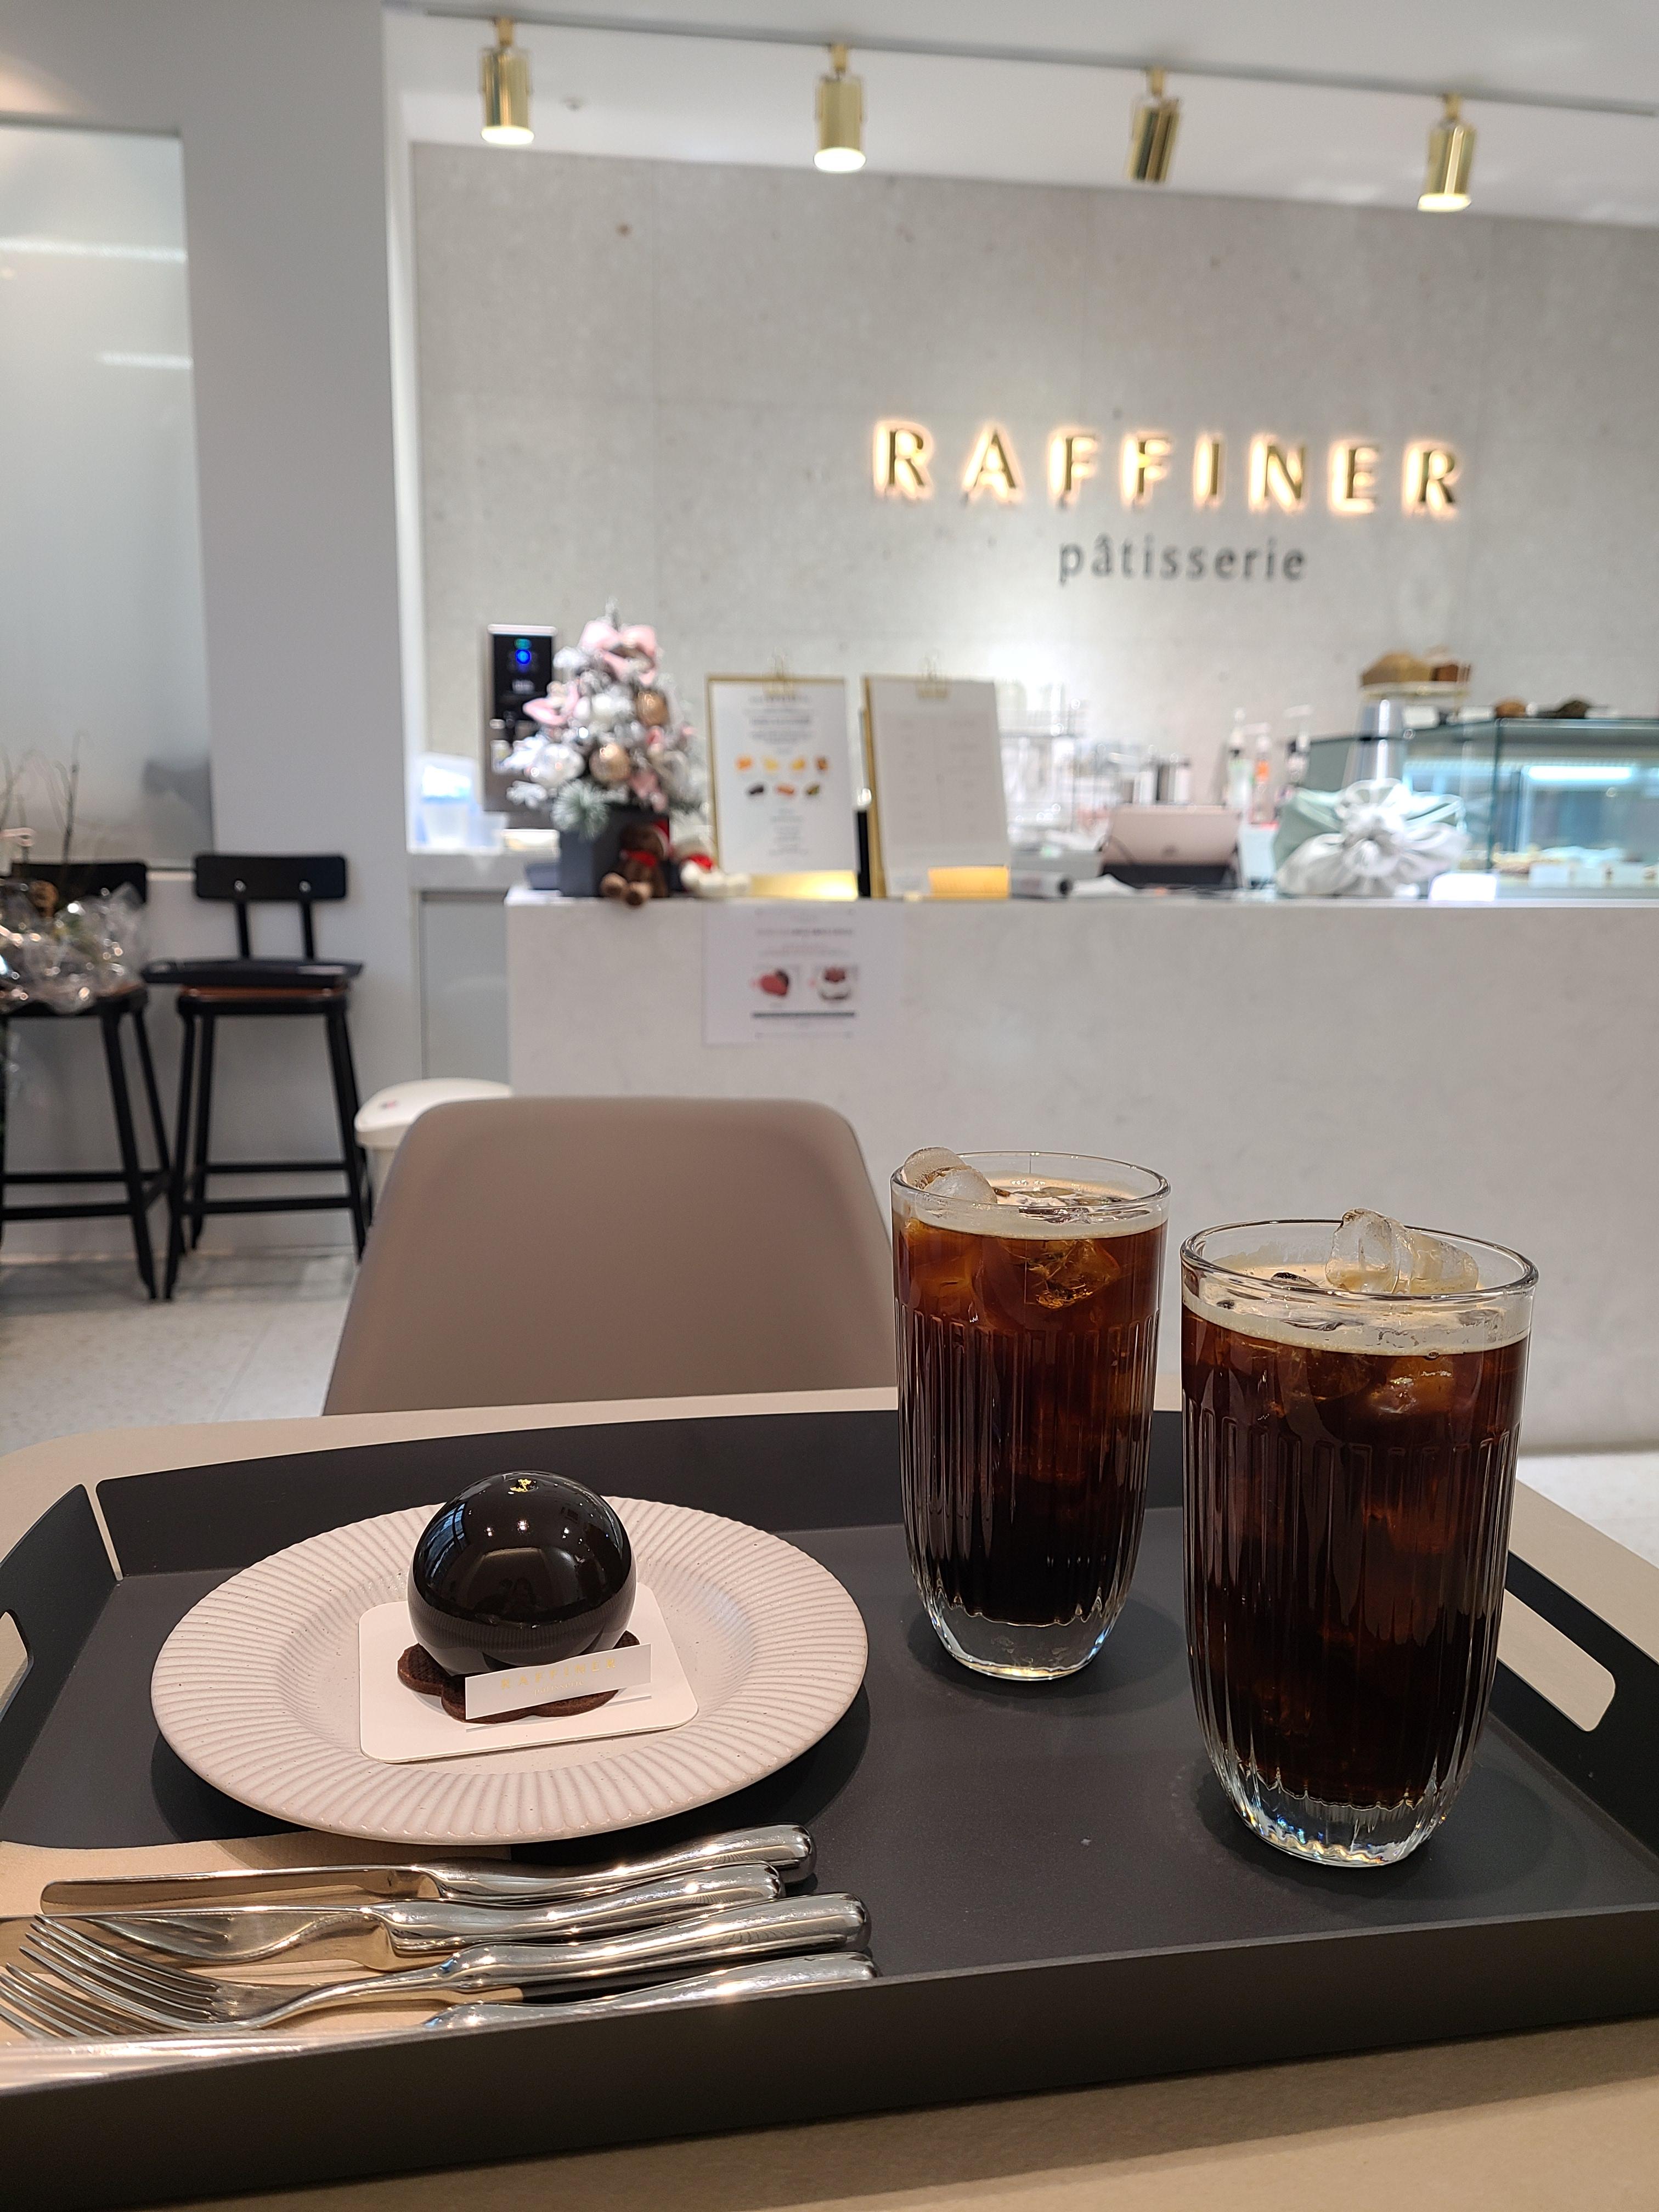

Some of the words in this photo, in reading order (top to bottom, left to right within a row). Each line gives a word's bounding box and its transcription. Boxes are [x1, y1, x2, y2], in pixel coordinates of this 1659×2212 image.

[873, 421, 1462, 518] RAFFINER
[1059, 534, 1306, 586] pâtisserie
[500, 1658, 616, 1690] RAFFINER
